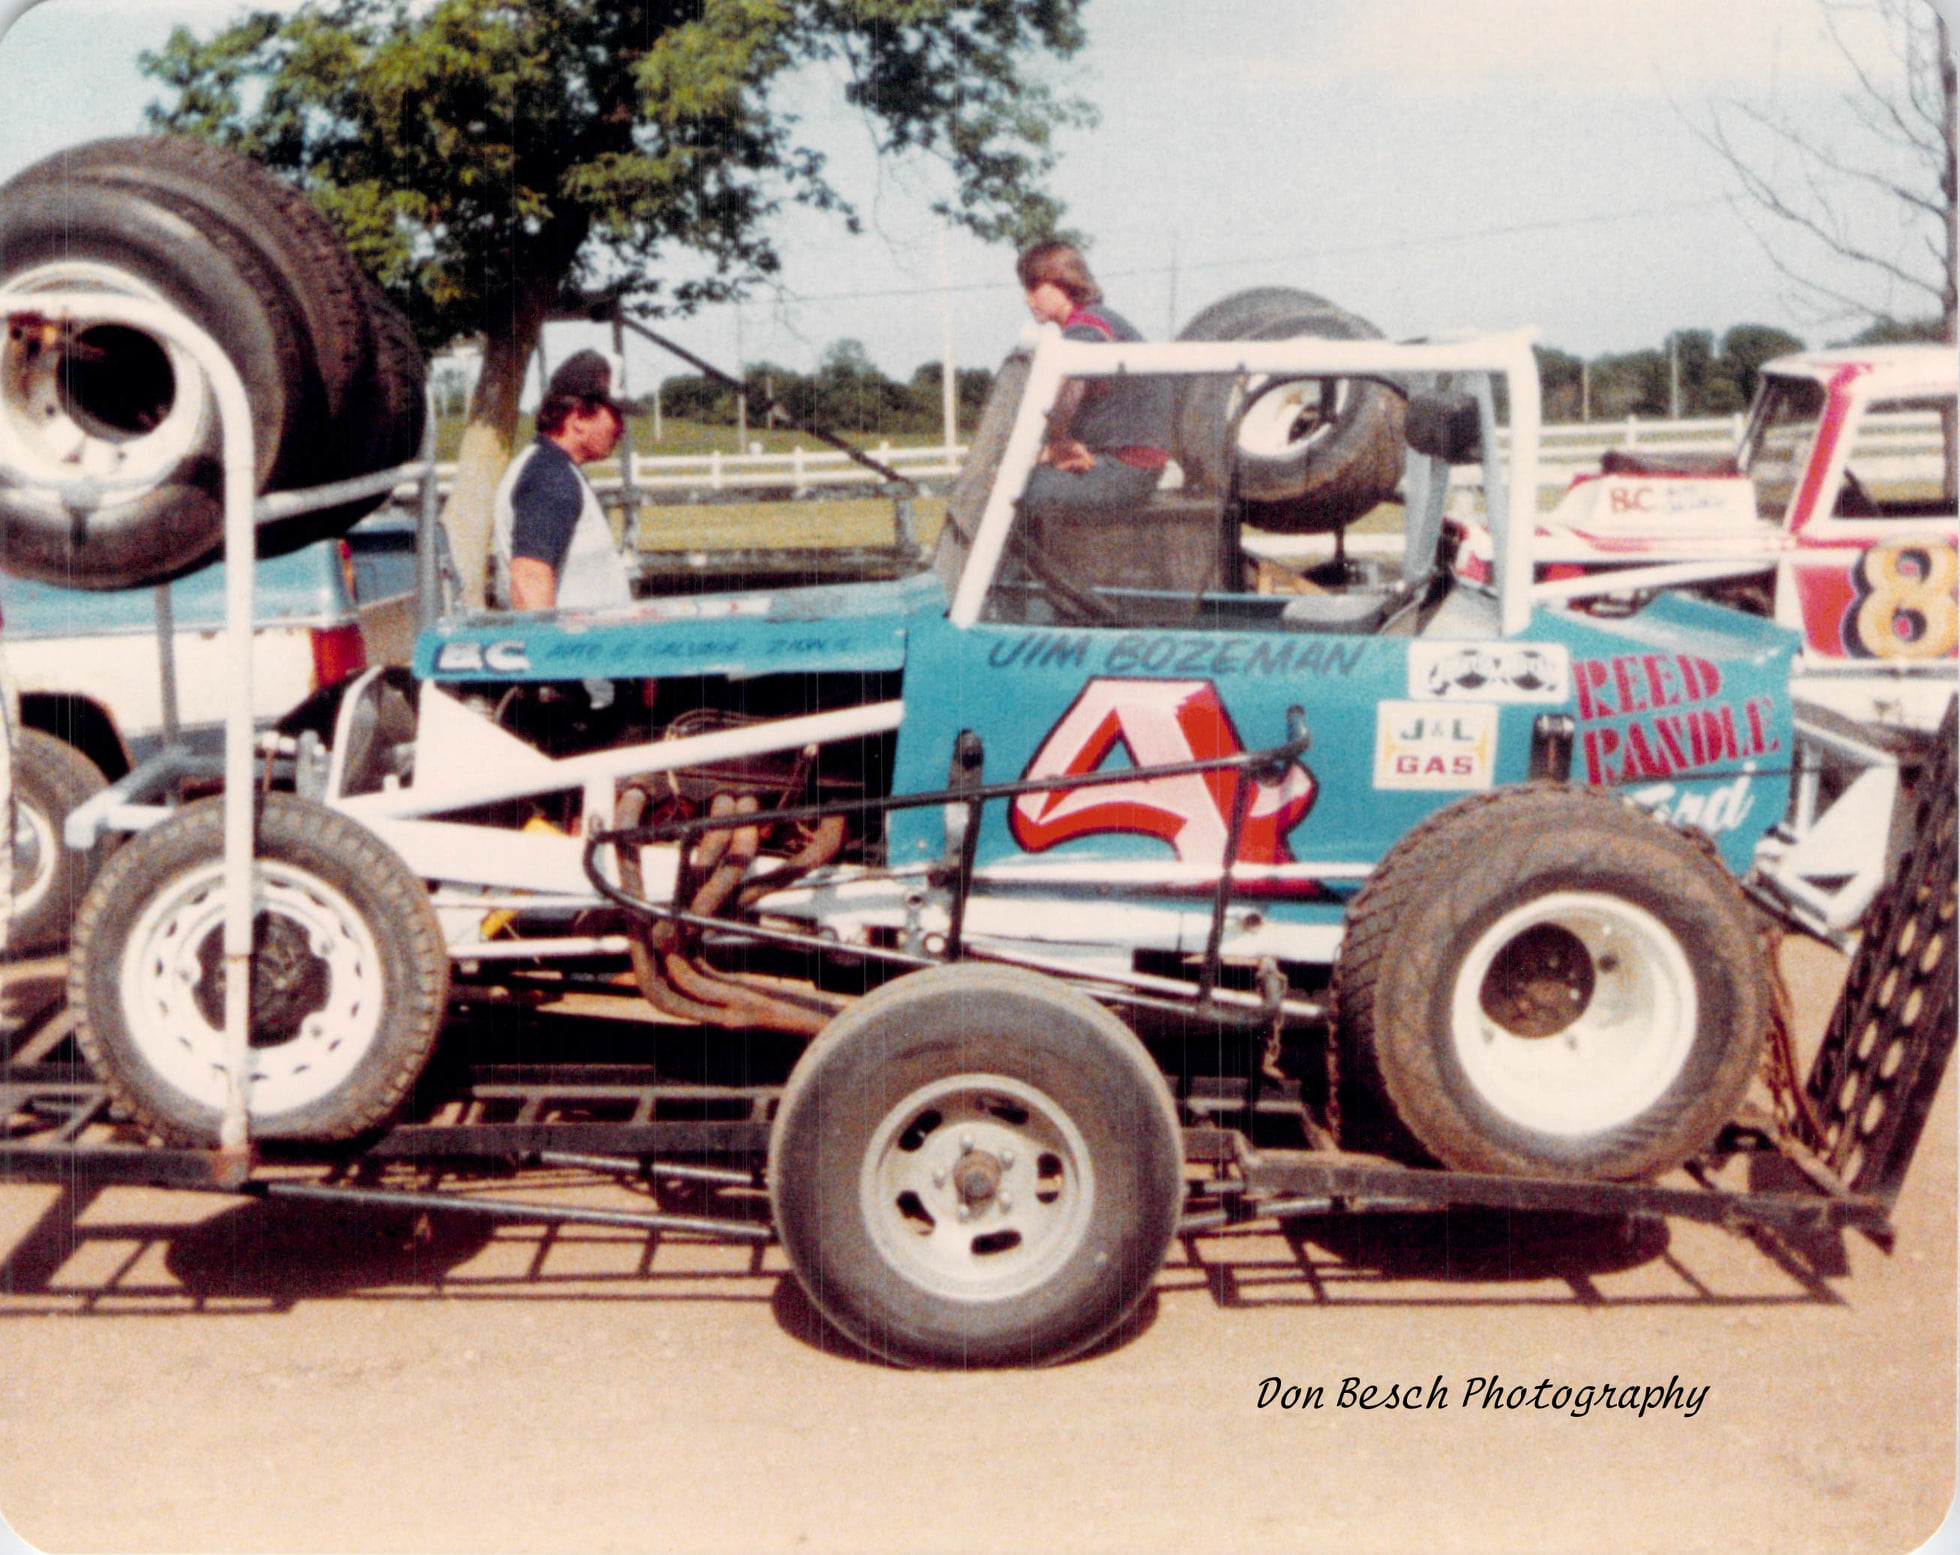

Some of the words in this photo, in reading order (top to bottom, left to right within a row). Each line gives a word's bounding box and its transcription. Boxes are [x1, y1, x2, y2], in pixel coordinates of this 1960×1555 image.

[1841, 533, 1959, 660] 8
[1105, 634, 1367, 676] BOZEMAN
[1572, 654, 1722, 721] REED
[1395, 755, 1474, 775] GAS
[1583, 696, 1779, 785] RANDLE
